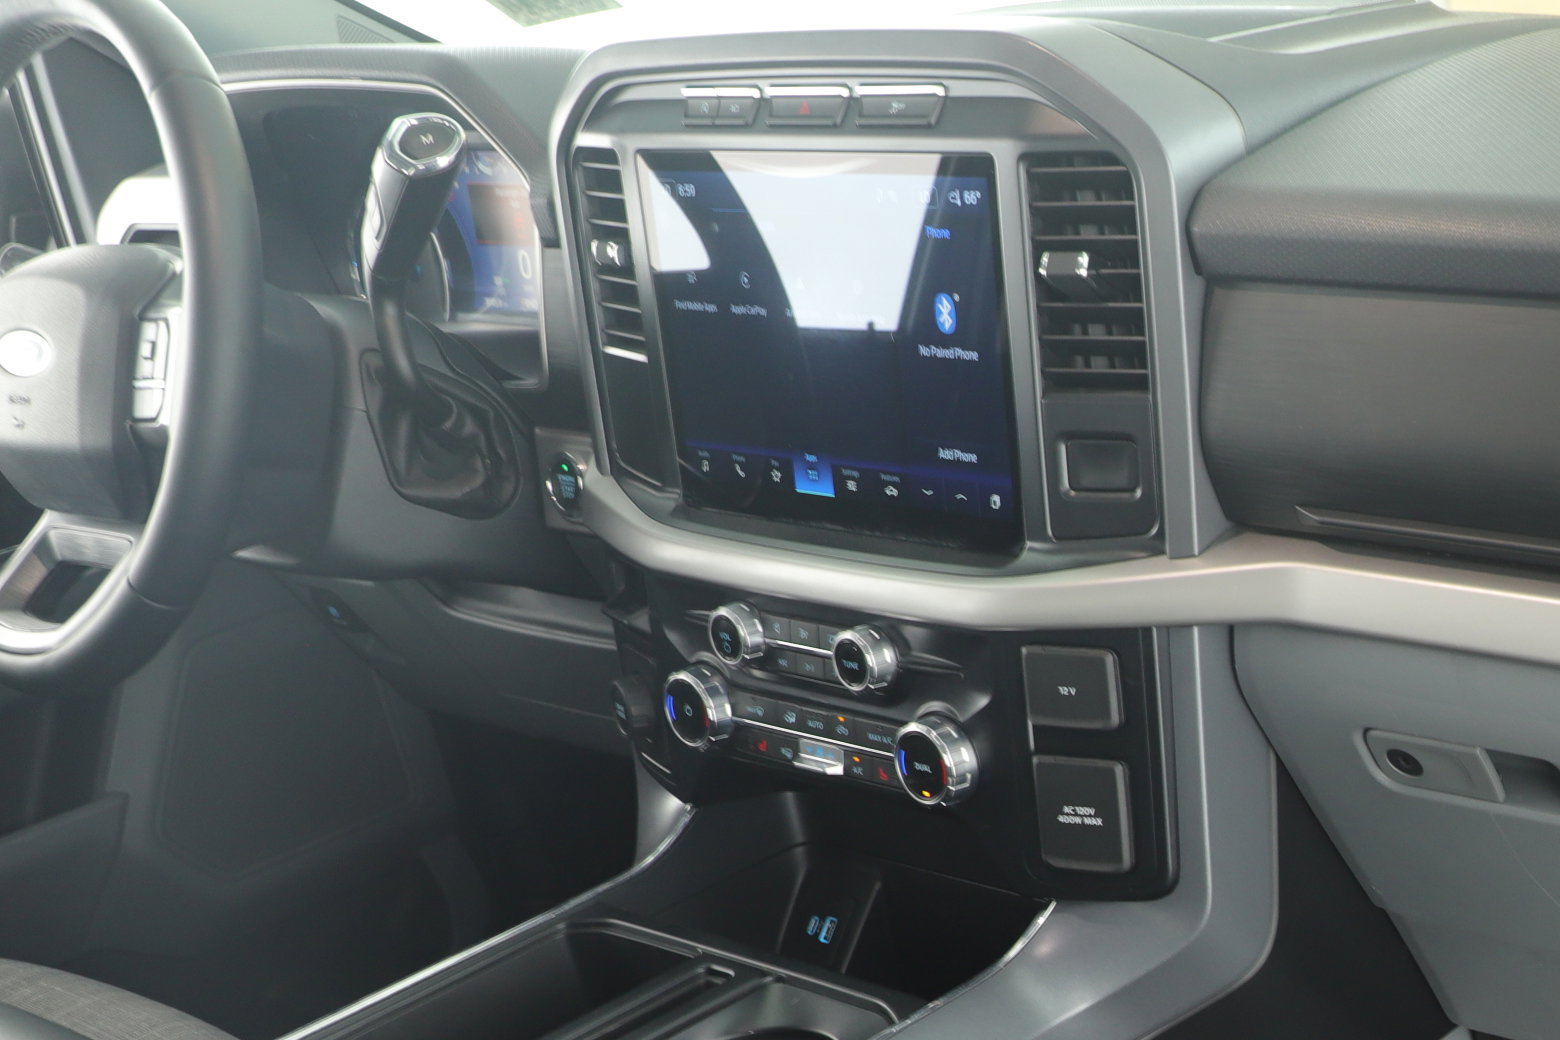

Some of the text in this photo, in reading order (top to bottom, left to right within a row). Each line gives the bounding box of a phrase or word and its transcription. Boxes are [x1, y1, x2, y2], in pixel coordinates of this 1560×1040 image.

[418, 133, 434, 145] M
[925, 226, 951, 240] Phone
[918, 344, 979, 361] No Paired Phone
[938, 447, 978, 463] Add Phone
[807, 718, 824, 731] AUTO
[1063, 805, 1074, 815] AC
[1083, 816, 1103, 828] MAX
